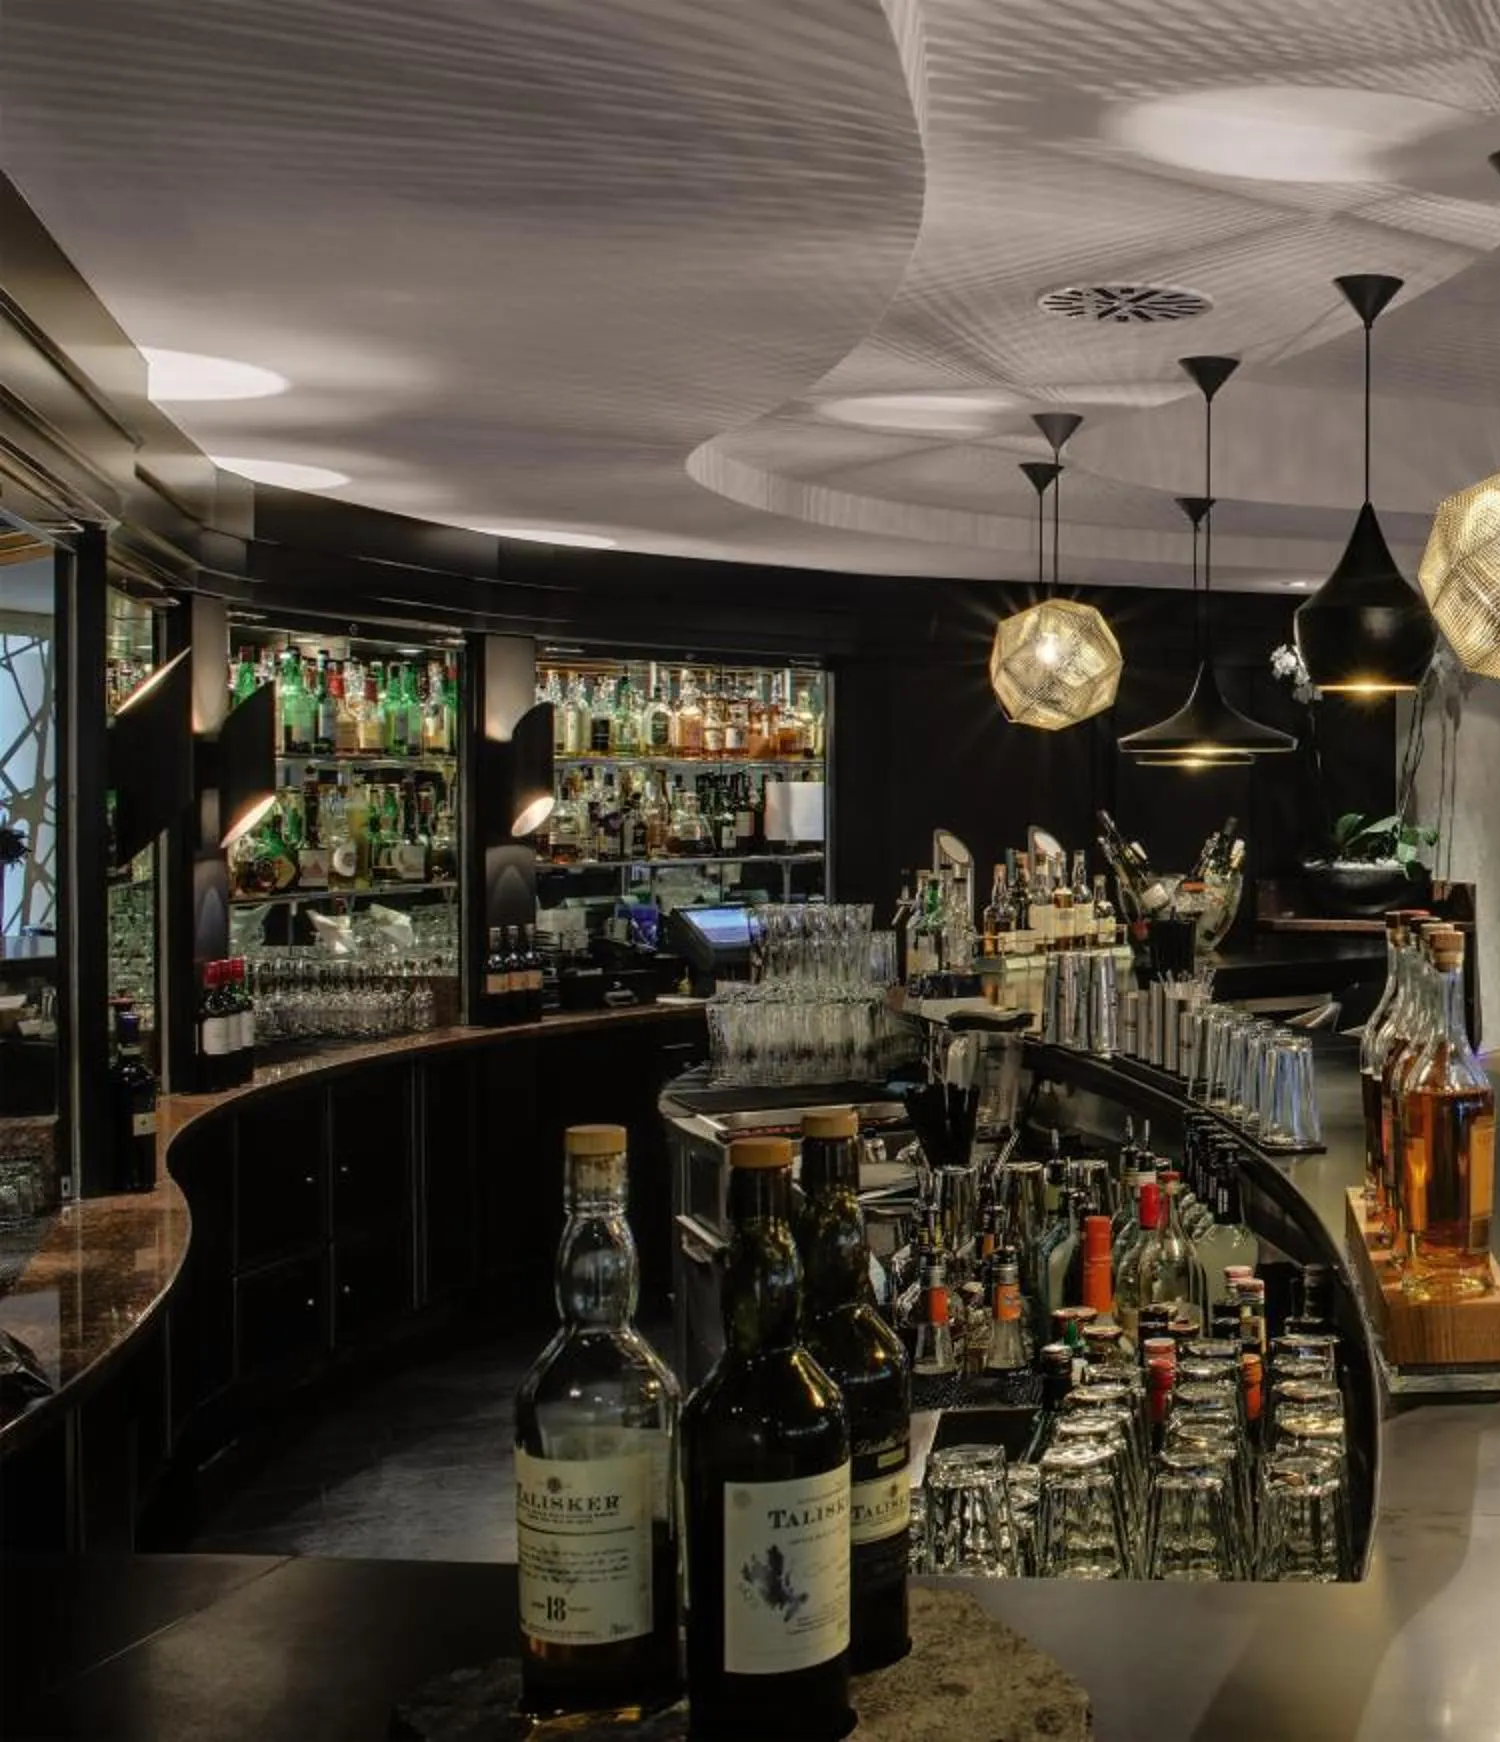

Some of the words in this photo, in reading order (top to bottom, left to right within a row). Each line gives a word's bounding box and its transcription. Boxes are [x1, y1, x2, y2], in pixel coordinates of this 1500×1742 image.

[767, 1497, 849, 1529] TALISK
[851, 1495, 907, 1521] TALIS
[546, 1595, 567, 1621] 18
